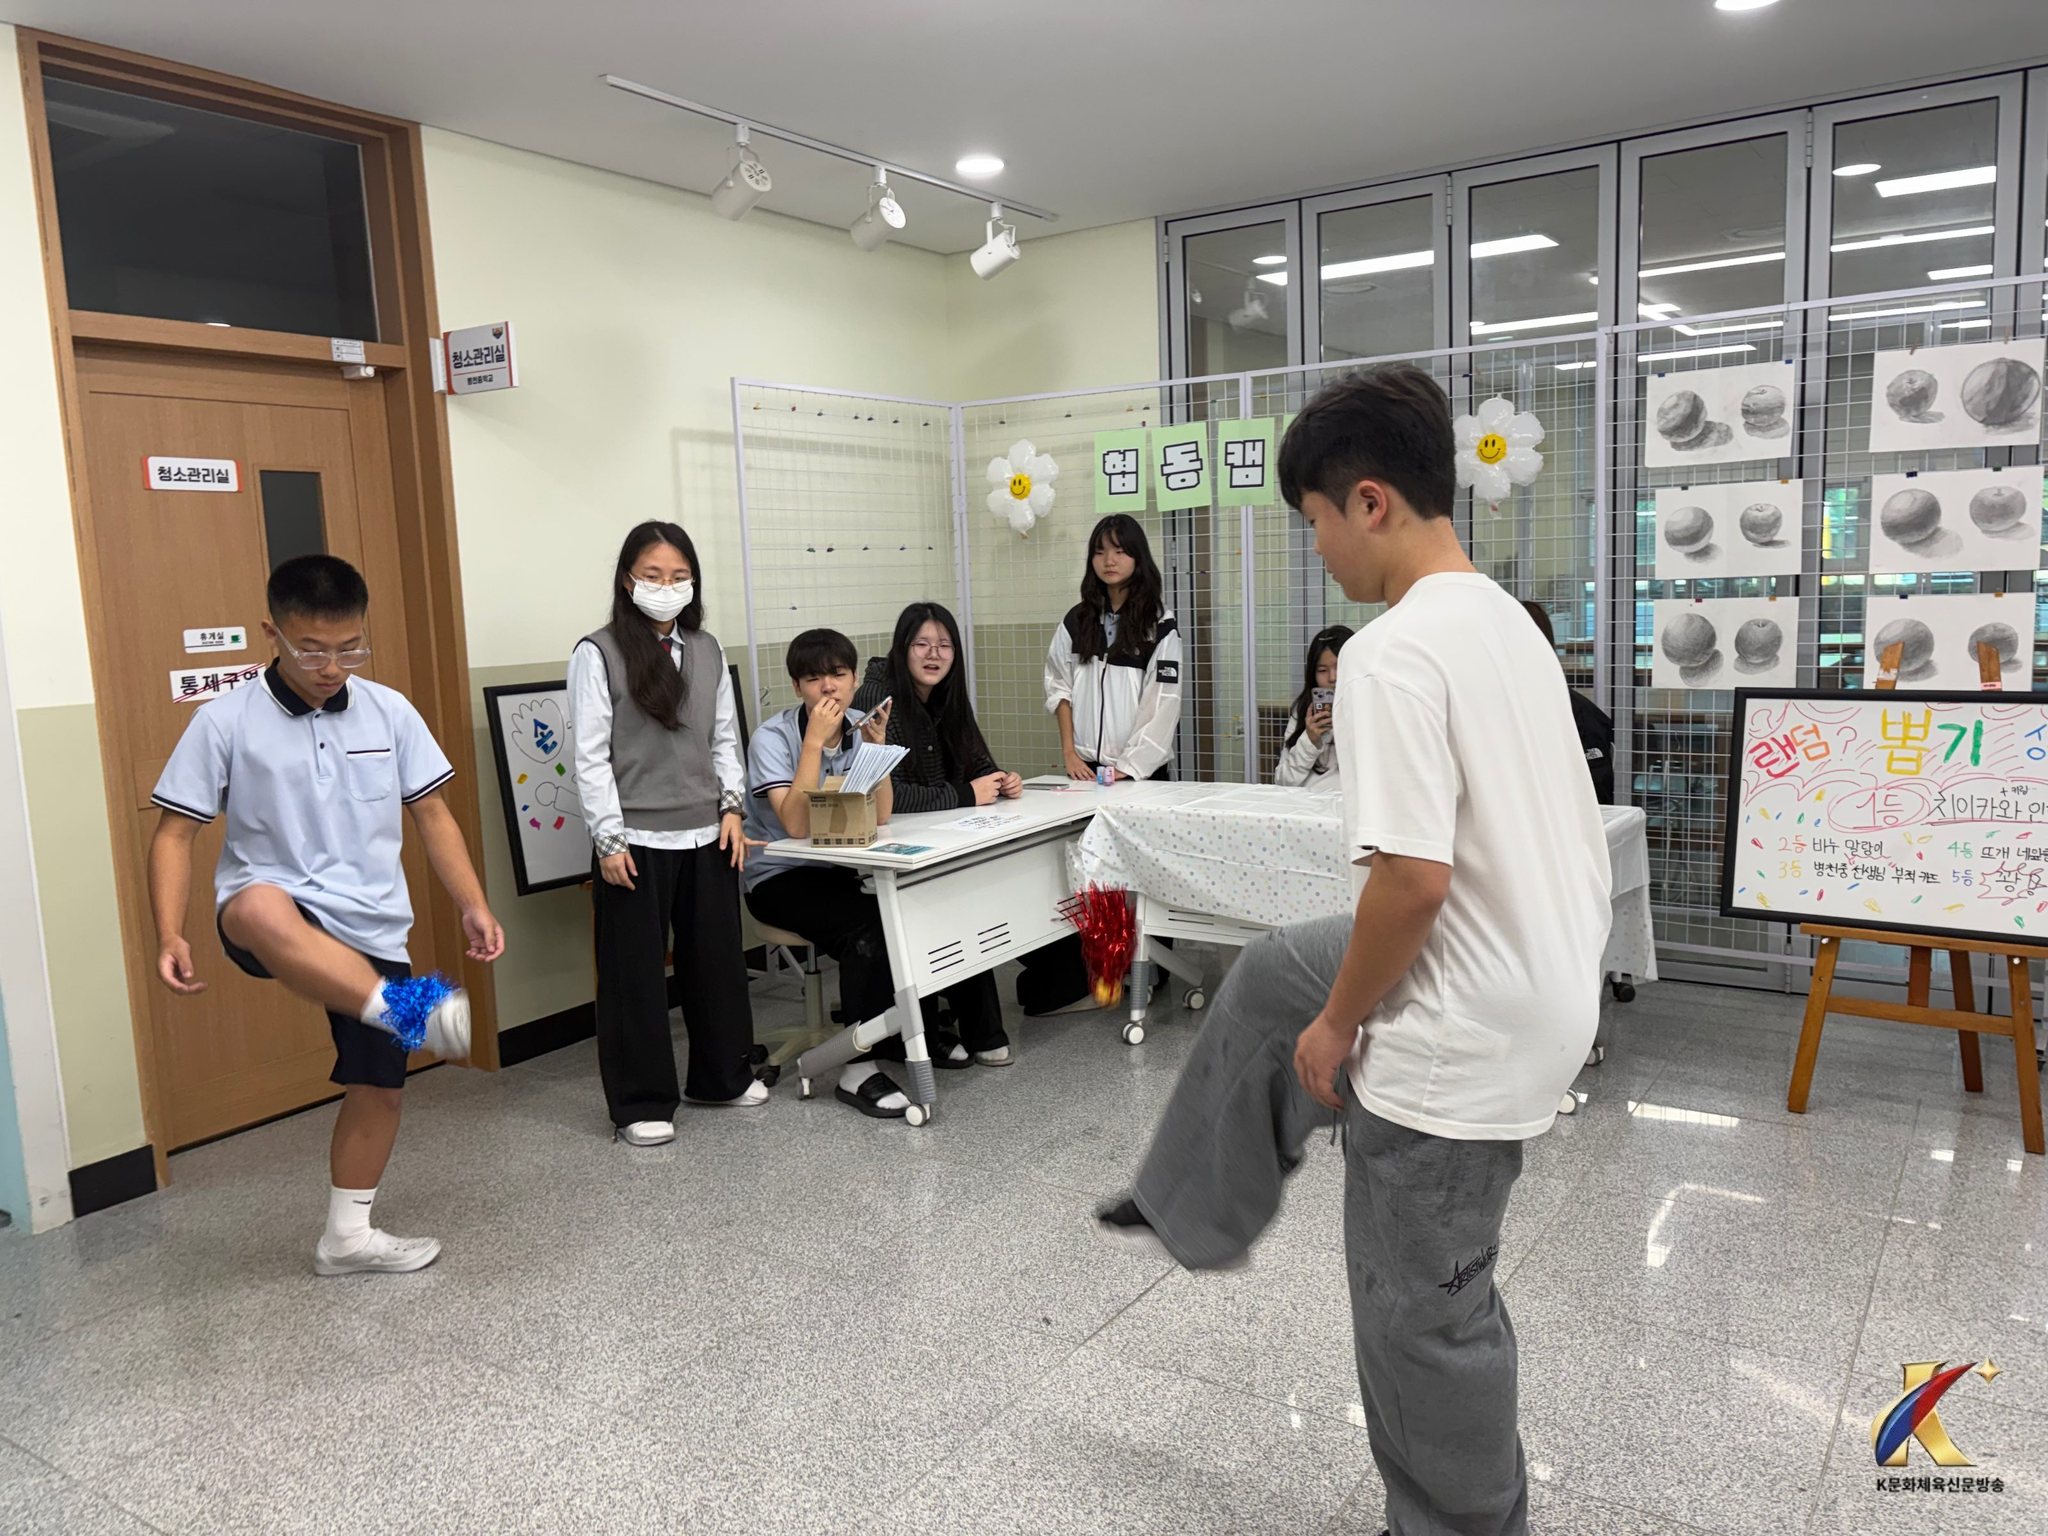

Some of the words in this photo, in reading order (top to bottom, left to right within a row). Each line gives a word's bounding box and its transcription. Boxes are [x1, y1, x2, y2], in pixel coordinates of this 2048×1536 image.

[452, 344, 505, 369] 청소관리실
[158, 466, 230, 483] 청소관리실
[200, 632, 224, 640] 휴게실
[1748, 723, 1830, 778] 랜덤
[1877, 708, 1983, 776] 뽑기
[1856, 791, 1904, 826] 1등
[1778, 835, 1807, 854] 2등
[1845, 839, 1883, 856] 말랑이
[1947, 841, 1973, 859] 4등
[1980, 846, 2009, 859] 뜨개
[1778, 860, 1802, 878] 3등
[1814, 861, 1848, 879] 병천중
[1852, 863, 1886, 882] 선생님
[1953, 869, 1974, 887] 5등
